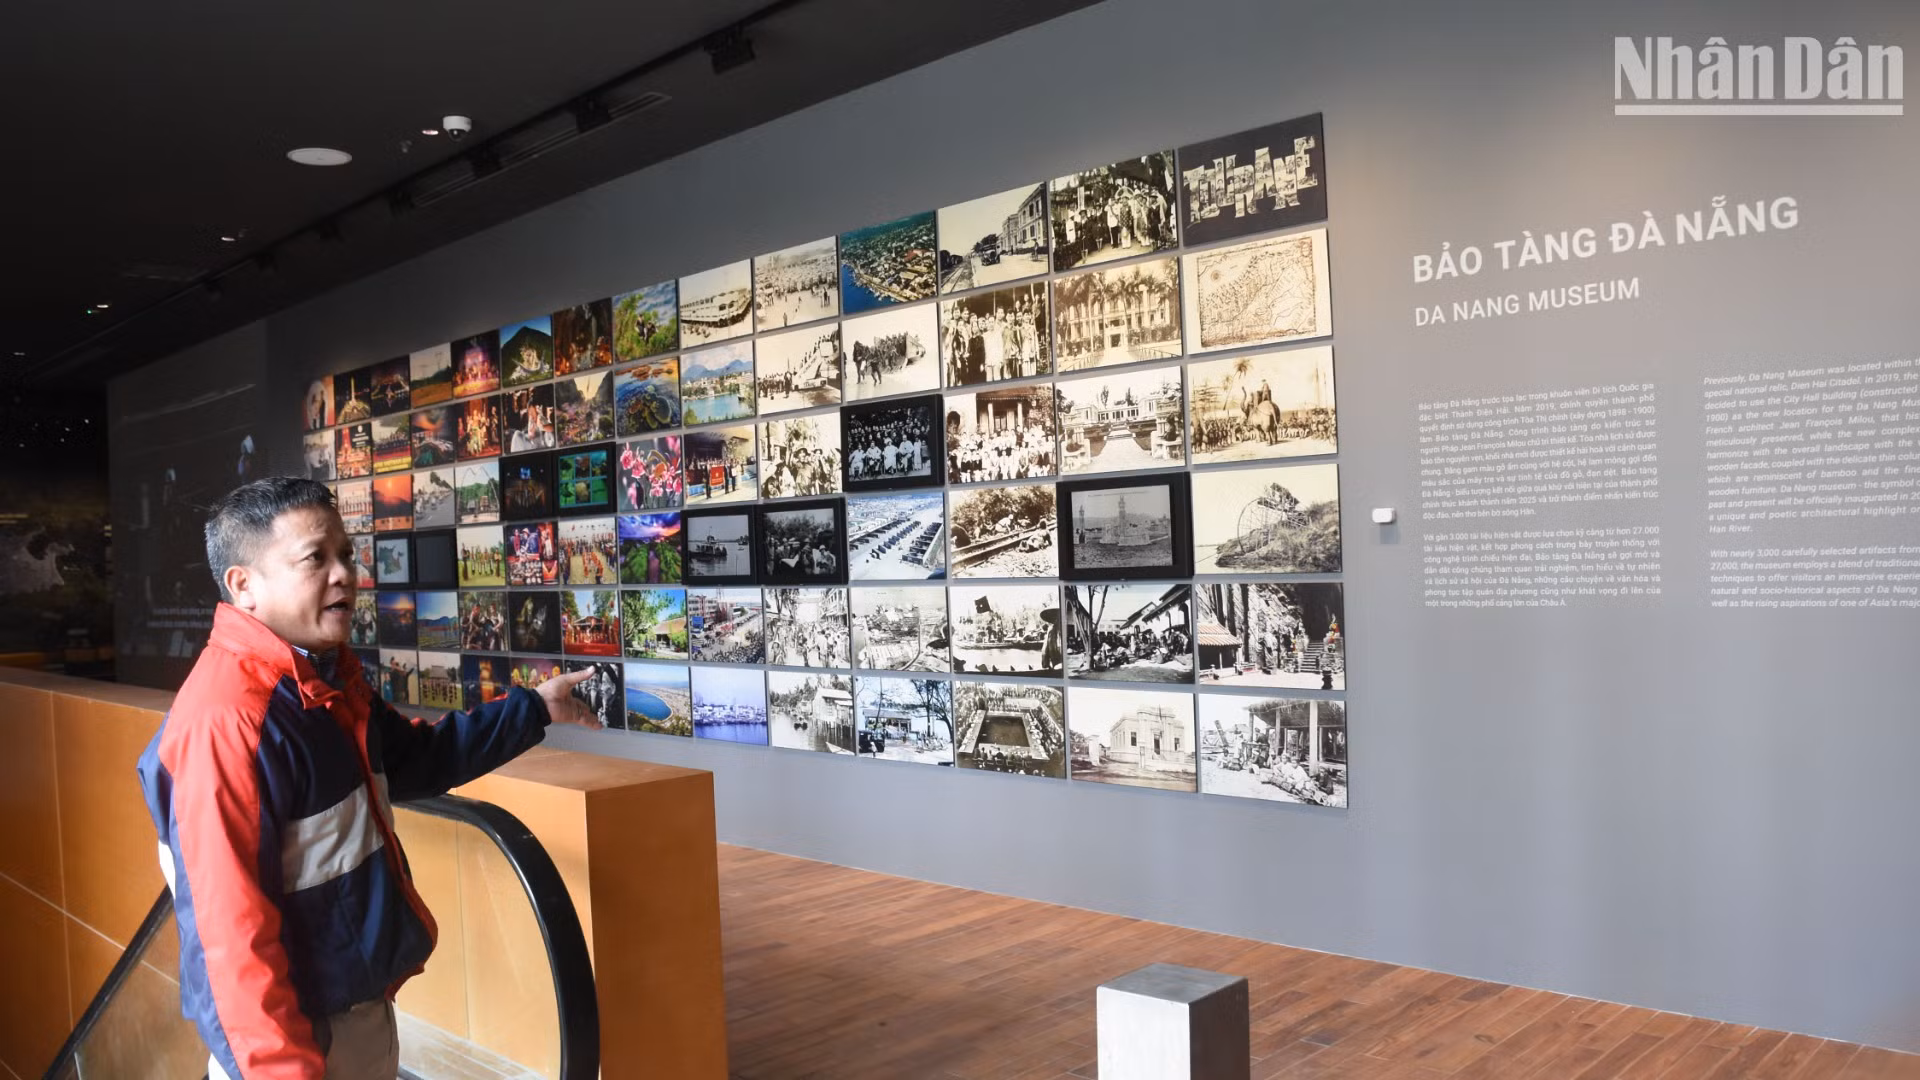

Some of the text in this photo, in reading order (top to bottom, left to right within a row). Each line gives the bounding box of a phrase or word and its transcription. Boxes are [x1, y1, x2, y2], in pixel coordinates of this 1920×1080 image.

[1413, 195, 1799, 283] BẢO TÀNG ĐÀ NẴNG
[1415, 277, 1640, 327] DA NANG MUSEUM
[1704, 358, 1912, 388] Previously, Da Nang Museum was located within
[1704, 387, 1732, 400] special
[1735, 384, 1767, 396] national
[1813, 379, 1827, 389] Hai
[1865, 375, 1874, 385] In
[1877, 372, 1901, 386] 2019,
[1904, 371, 1919, 381] the
[1536, 402, 1556, 414] 2019,
[1561, 400, 1581, 410] chính
[1705, 399, 1736, 411] decided
[1739, 398, 1748, 408] to
[1768, 396, 1781, 406] the
[1784, 394, 1800, 406] City
[1803, 392, 1820, 403] Hall
[1823, 389, 1857, 403] building
[1861, 384, 1918, 400] (constructed
[1608, 408, 1627, 418] 1898
[1633, 405, 1656, 418] 1900)
[1705, 412, 1729, 425] 1900)
[1746, 410, 1759, 420] the
[1784, 405, 1818, 417] location
[1822, 404, 1834, 414] for
[1839, 403, 1852, 413] the
[1857, 401, 1869, 411] Da
[1874, 399, 1897, 412] Nang
[1706, 425, 1733, 435] French
[1739, 422, 1774, 433] architect
[1780, 420, 1800, 430] Jean
[1807, 417, 1843, 430] François
[1882, 412, 1899, 423] that
[1706, 435, 1757, 449] meticulously
[1810, 430, 1832, 441] while
[1838, 429, 1852, 439] the
[1858, 430, 1876, 438] new
[1707, 438, 1912, 460] harmonize with the overall landscape with the
[1707, 462, 1739, 472] wooden
[1772, 458, 1805, 471] coupled
[1807, 457, 1825, 467] with
[1827, 456, 1840, 465] the
[1842, 454, 1877, 465] delicate
[1879, 452, 1896, 463] thin
[1707, 475, 1731, 484] which
[1754, 471, 1802, 482] reminiscent
[1807, 470, 1816, 479] of
[1822, 468, 1857, 479] bamboo
[1863, 467, 1879, 477] and
[1885, 466, 1899, 475] the
[1708, 487, 1740, 497] wooden
[1781, 484, 1792, 493] Da
[1794, 483, 1817, 495] Nang
[1819, 484, 1856, 492] museum
[1864, 480, 1878, 490] the
[1881, 478, 1914, 491] symbol
[1519, 495, 1537, 504] 2025
[1717, 512, 1746, 523] unique
[1750, 511, 1766, 520] and
[1769, 510, 1798, 521] poetic
[1801, 507, 1861, 518] architectural
[1864, 505, 1907, 518] highlight
[1709, 525, 1727, 534] Han
[1710, 549, 1728, 558] With
[1731, 548, 1755, 559] nearly
[1758, 548, 1780, 559] 3,000
[1783, 547, 1818, 558] carefully
[1821, 546, 1857, 556] selected
[1860, 545, 1896, 555] artifacts
[1711, 574, 1754, 584] techniques
[1758, 574, 1766, 582] to
[1769, 573, 1788, 582] offer
[1792, 573, 1822, 582] visitors
[1839, 572, 1884, 581] immersive
[1711, 585, 1919, 596] natural and socio-historical aspects of Da Nang
[1712, 599, 1727, 607] well
[1741, 599, 1754, 607] the
[1756, 599, 1778, 609] rising
[1781, 599, 1827, 609] aspirations
[1829, 599, 1838, 607] of
[1859, 599, 1868, 607] of
[1871, 599, 1897, 607] Asia's
